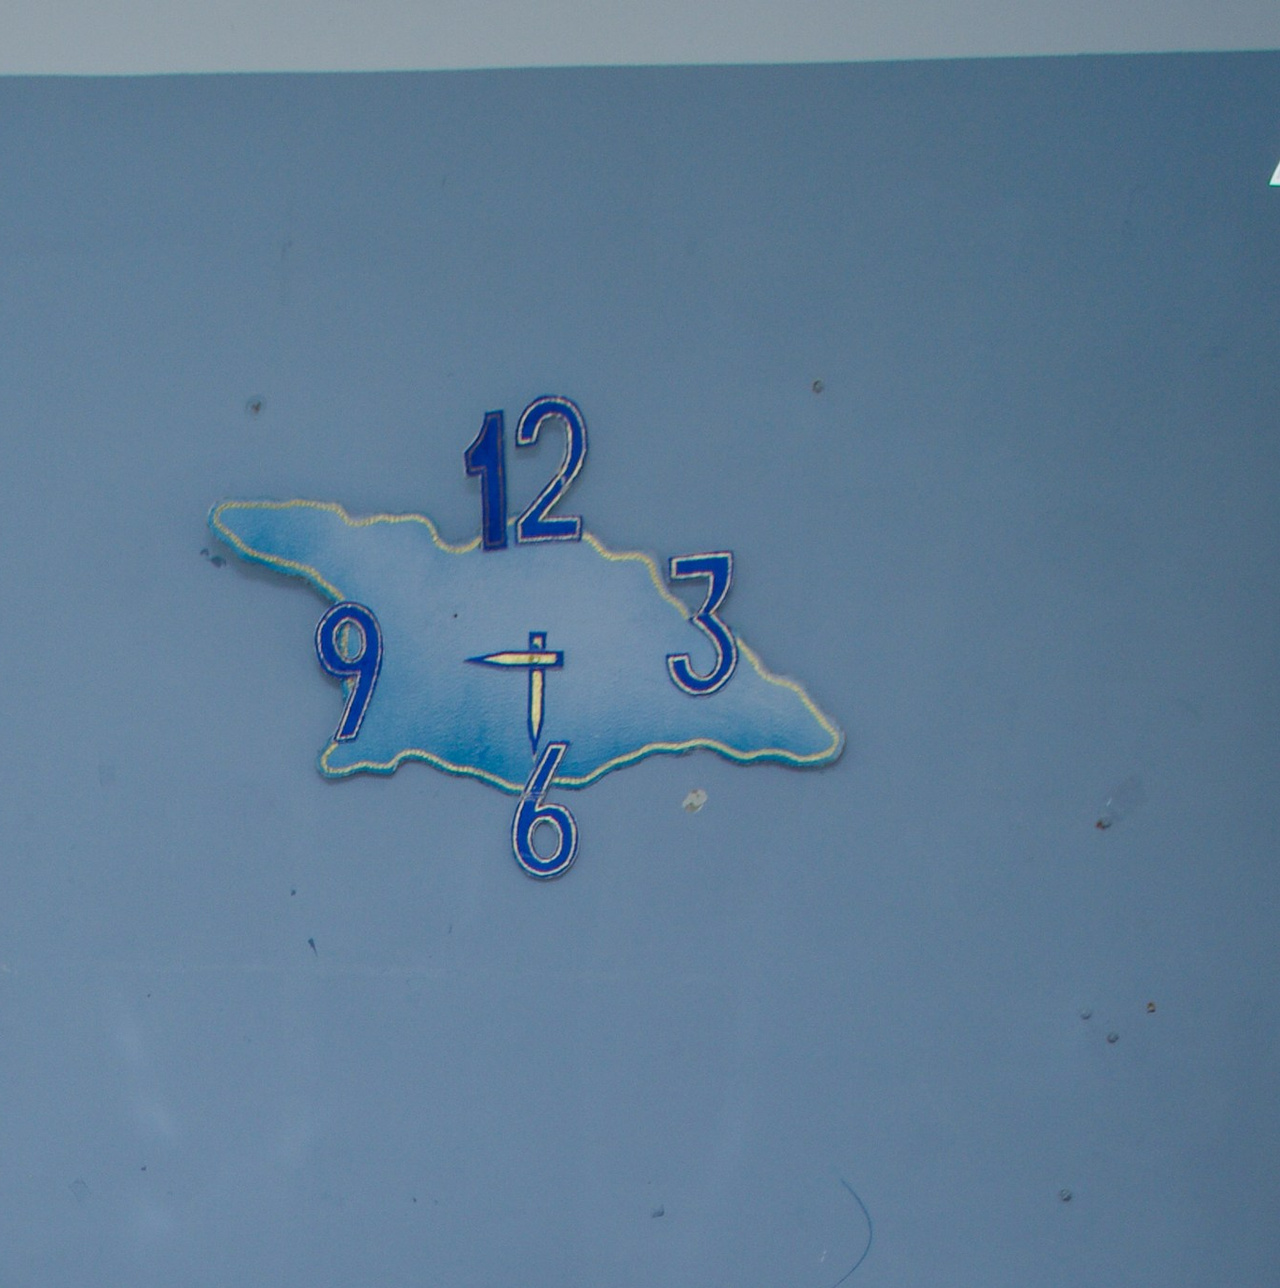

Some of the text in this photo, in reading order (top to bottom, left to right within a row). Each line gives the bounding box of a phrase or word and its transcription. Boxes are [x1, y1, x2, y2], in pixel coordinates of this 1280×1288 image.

[463, 394, 589, 551] 12
[314, 600, 383, 743] 9
[665, 549, 740, 696] 3
[510, 741, 580, 880] 6
